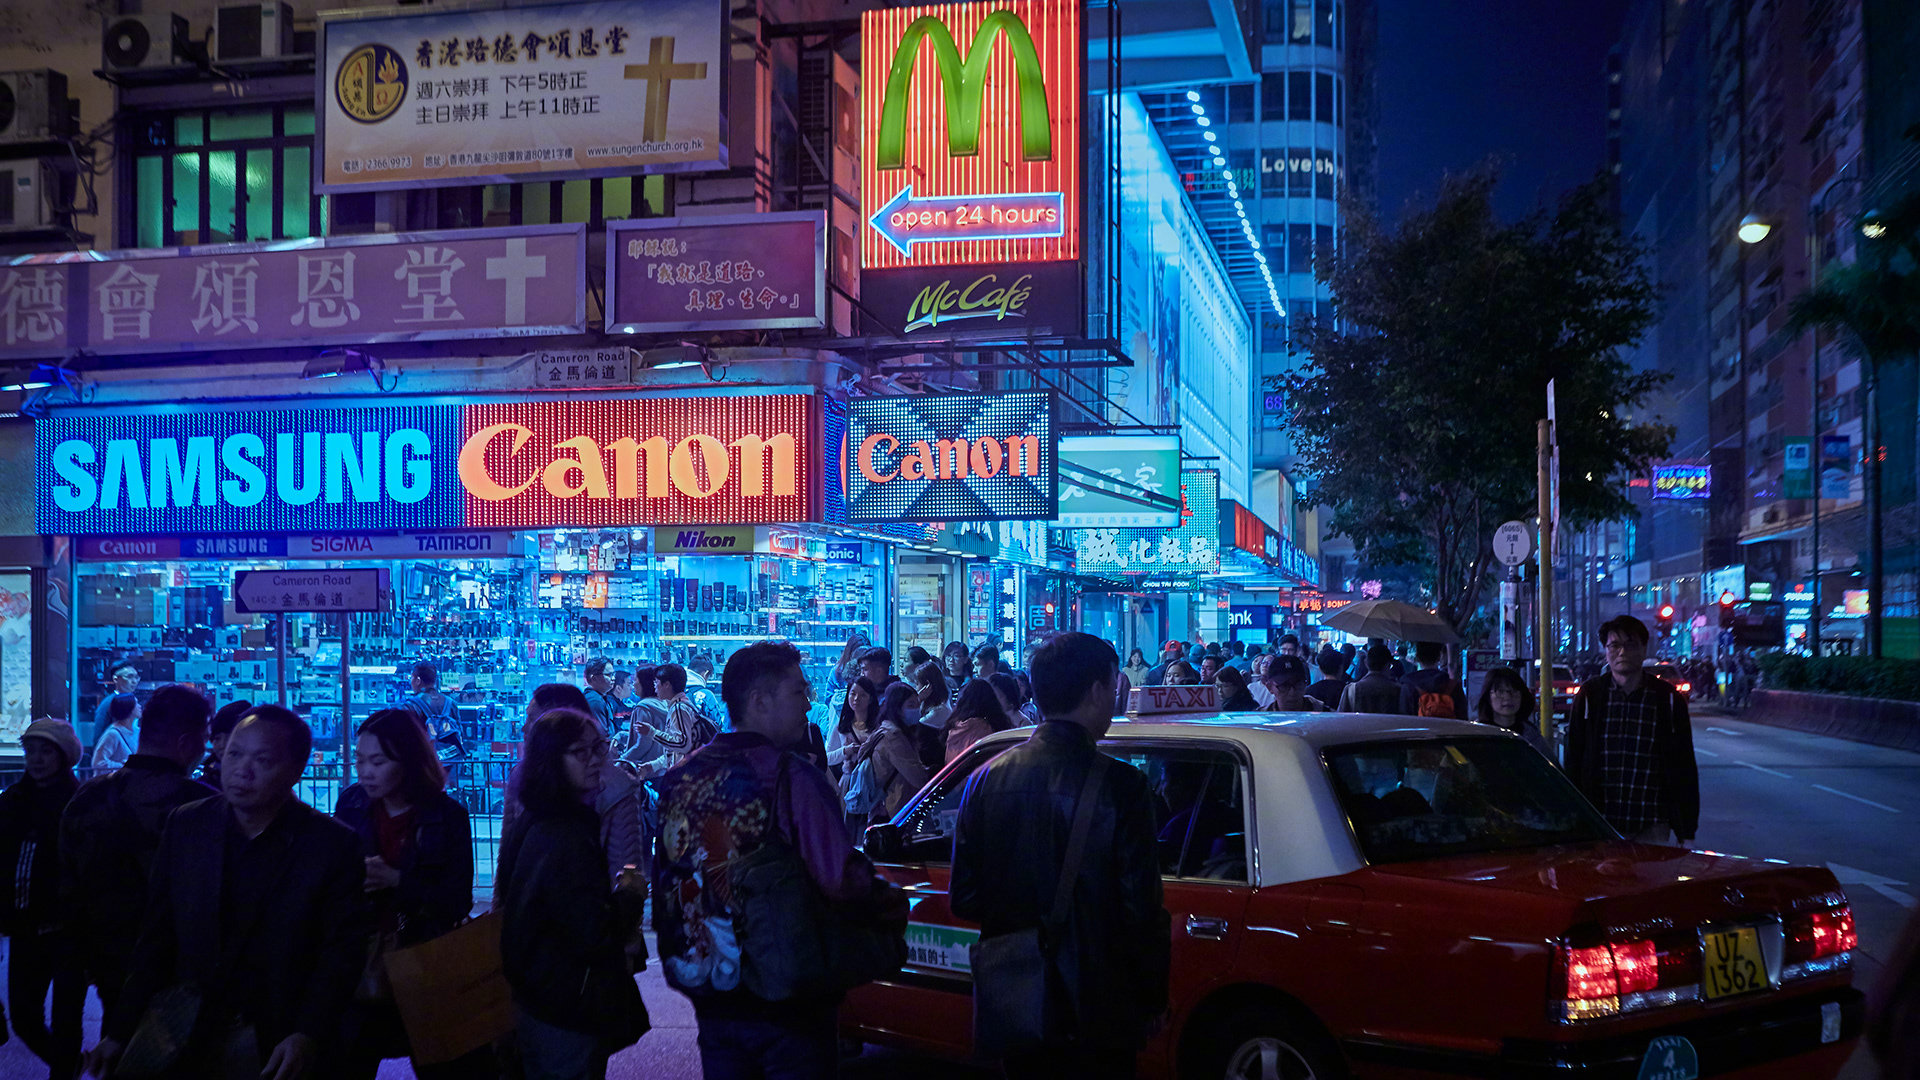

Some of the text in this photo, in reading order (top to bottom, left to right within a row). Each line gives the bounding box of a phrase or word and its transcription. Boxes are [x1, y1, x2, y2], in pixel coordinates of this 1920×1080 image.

[416, 26, 628, 68] 香港路德會頌恩堂
[416, 71, 587, 100] 週六崇拜 下午5時正
[416, 95, 600, 125] 主日崇拜 上午11時正
[587, 140, 703, 157] www.sungenchurch.org.hk
[890, 205, 1057, 231] open 24 hours
[907, 273, 1032, 326] McCafé
[541, 352, 625, 364] Cameron Road
[549, 365, 616, 381] 金馬倫道
[1265, 395, 1283, 411] 68
[459, 422, 796, 501] Canon
[857, 432, 1040, 484] Canon
[52, 428, 431, 512] SAMSUNG
[99, 539, 157, 555] Canon
[196, 537, 268, 553] SAMSUNG
[311, 536, 374, 552] SIGMA
[415, 535, 492, 551] TAMRON
[675, 530, 736, 548] Nikon
[773, 532, 796, 550] Canon
[273, 574, 352, 586] Cameron Road
[1142, 580, 1160, 588] CHOW
[1161, 580, 1172, 588] TAI
[282, 592, 344, 607] 金馬倫道
[1148, 687, 1215, 708] TAXI
[1715, 933, 1745, 962] UZ
[1710, 960, 1762, 994] 1362
[1663, 1049, 1676, 1069] 4
